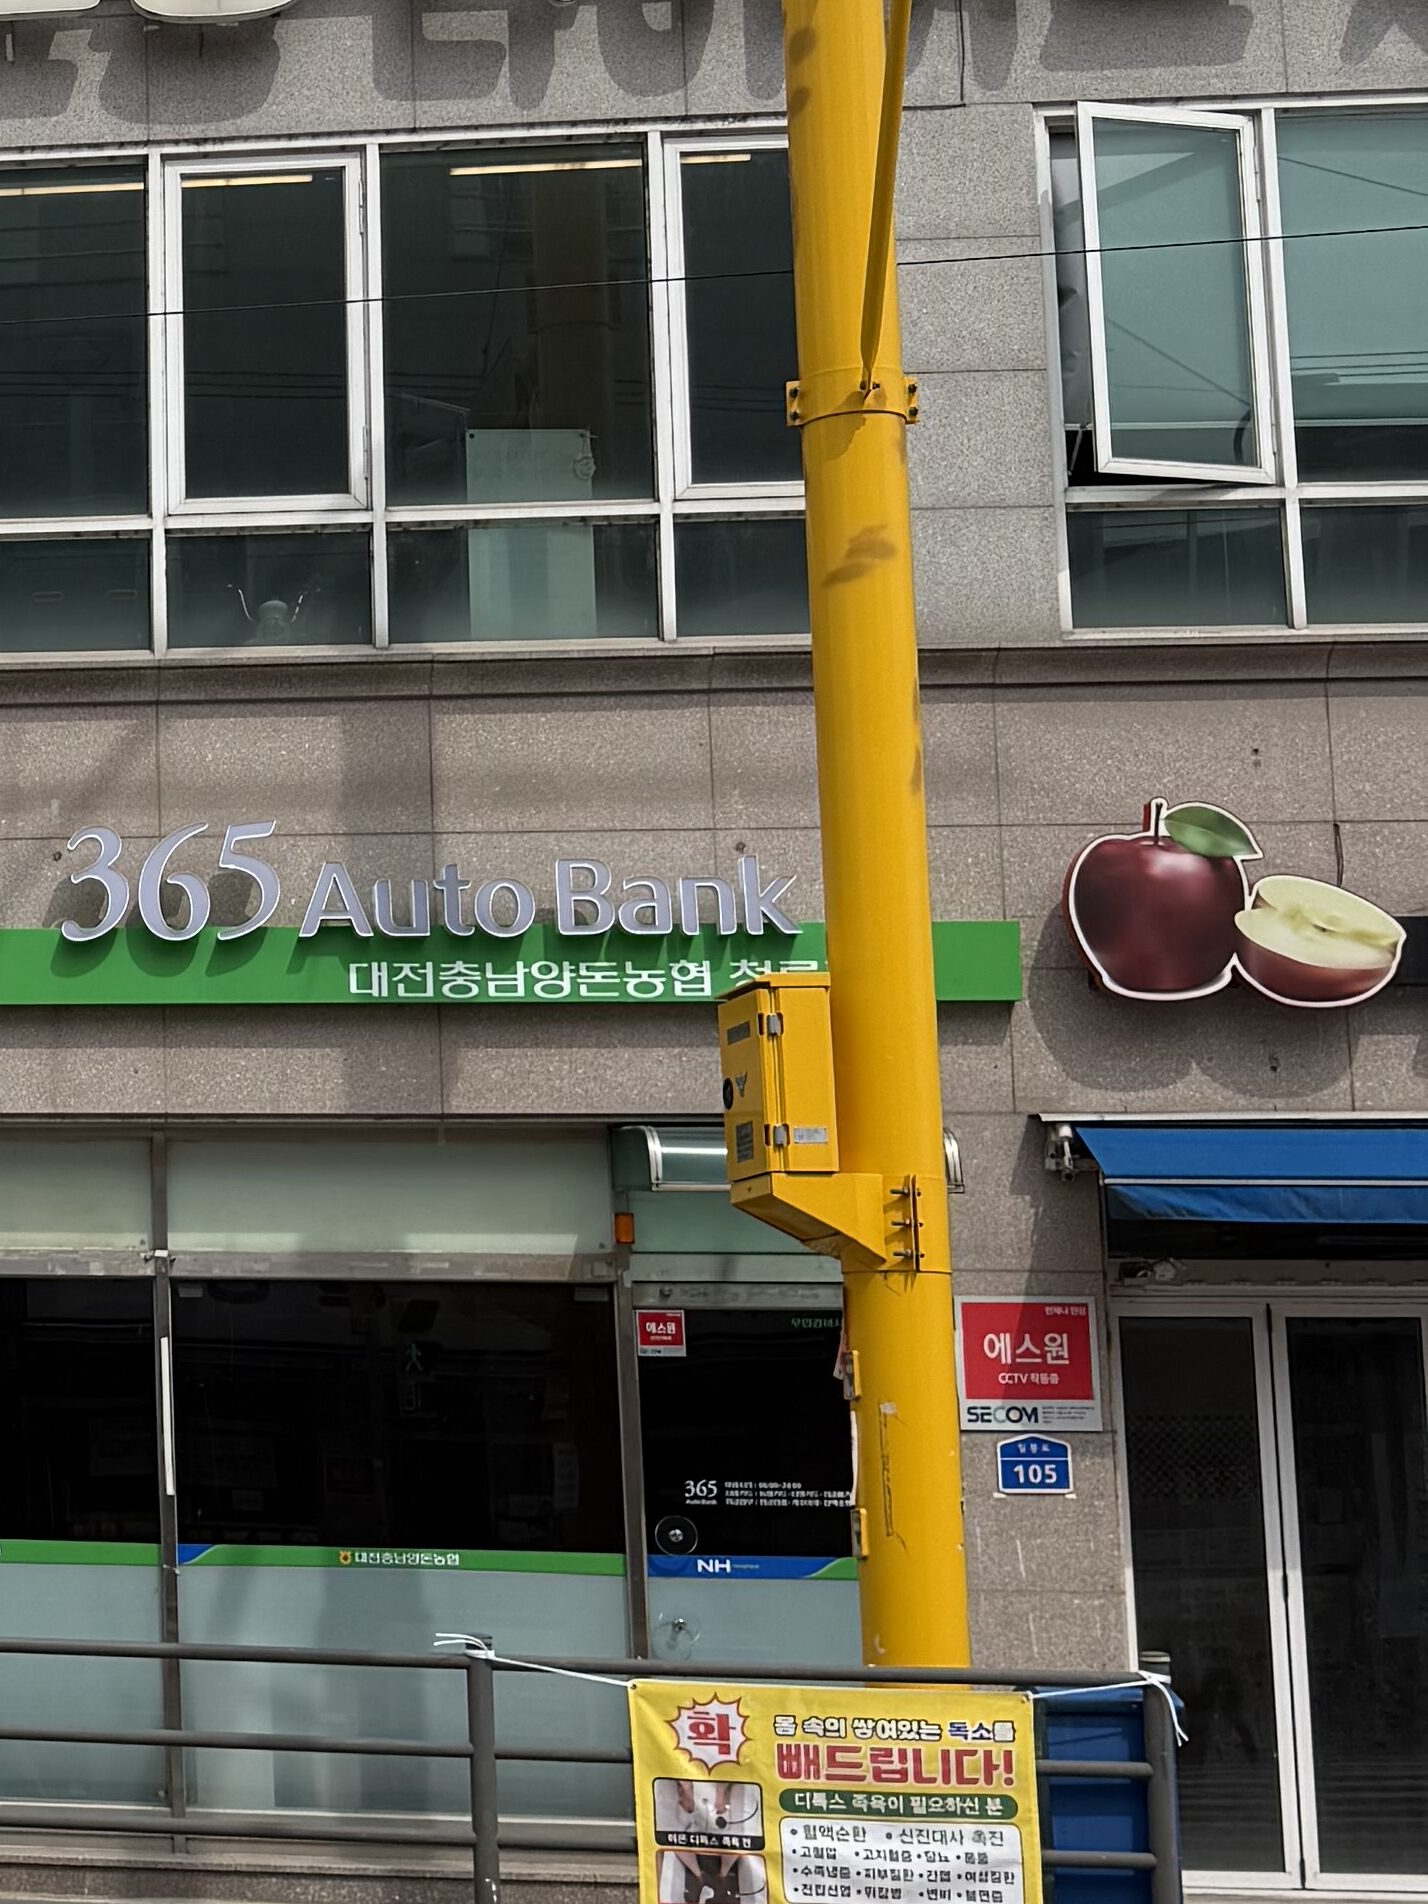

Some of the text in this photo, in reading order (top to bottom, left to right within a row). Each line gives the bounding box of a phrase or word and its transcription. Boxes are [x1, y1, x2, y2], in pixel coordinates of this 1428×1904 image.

[61, 820, 804, 942] 365 Auto Bank
[349, 960, 712, 998] 대전충남양돈농협
[983, 1332, 1070, 1364] 에스원
[998, 1373, 1028, 1385] CCTV
[967, 1406, 1039, 1423] SECOM
[1014, 1464, 1057, 1483] 105
[684, 1479, 718, 1498] 365
[697, 1559, 731, 1573] NH
[687, 1710, 736, 1756] 확
[777, 1743, 1015, 1786] 빼드립니다!
[899, 1828, 964, 1845] 신진대사
